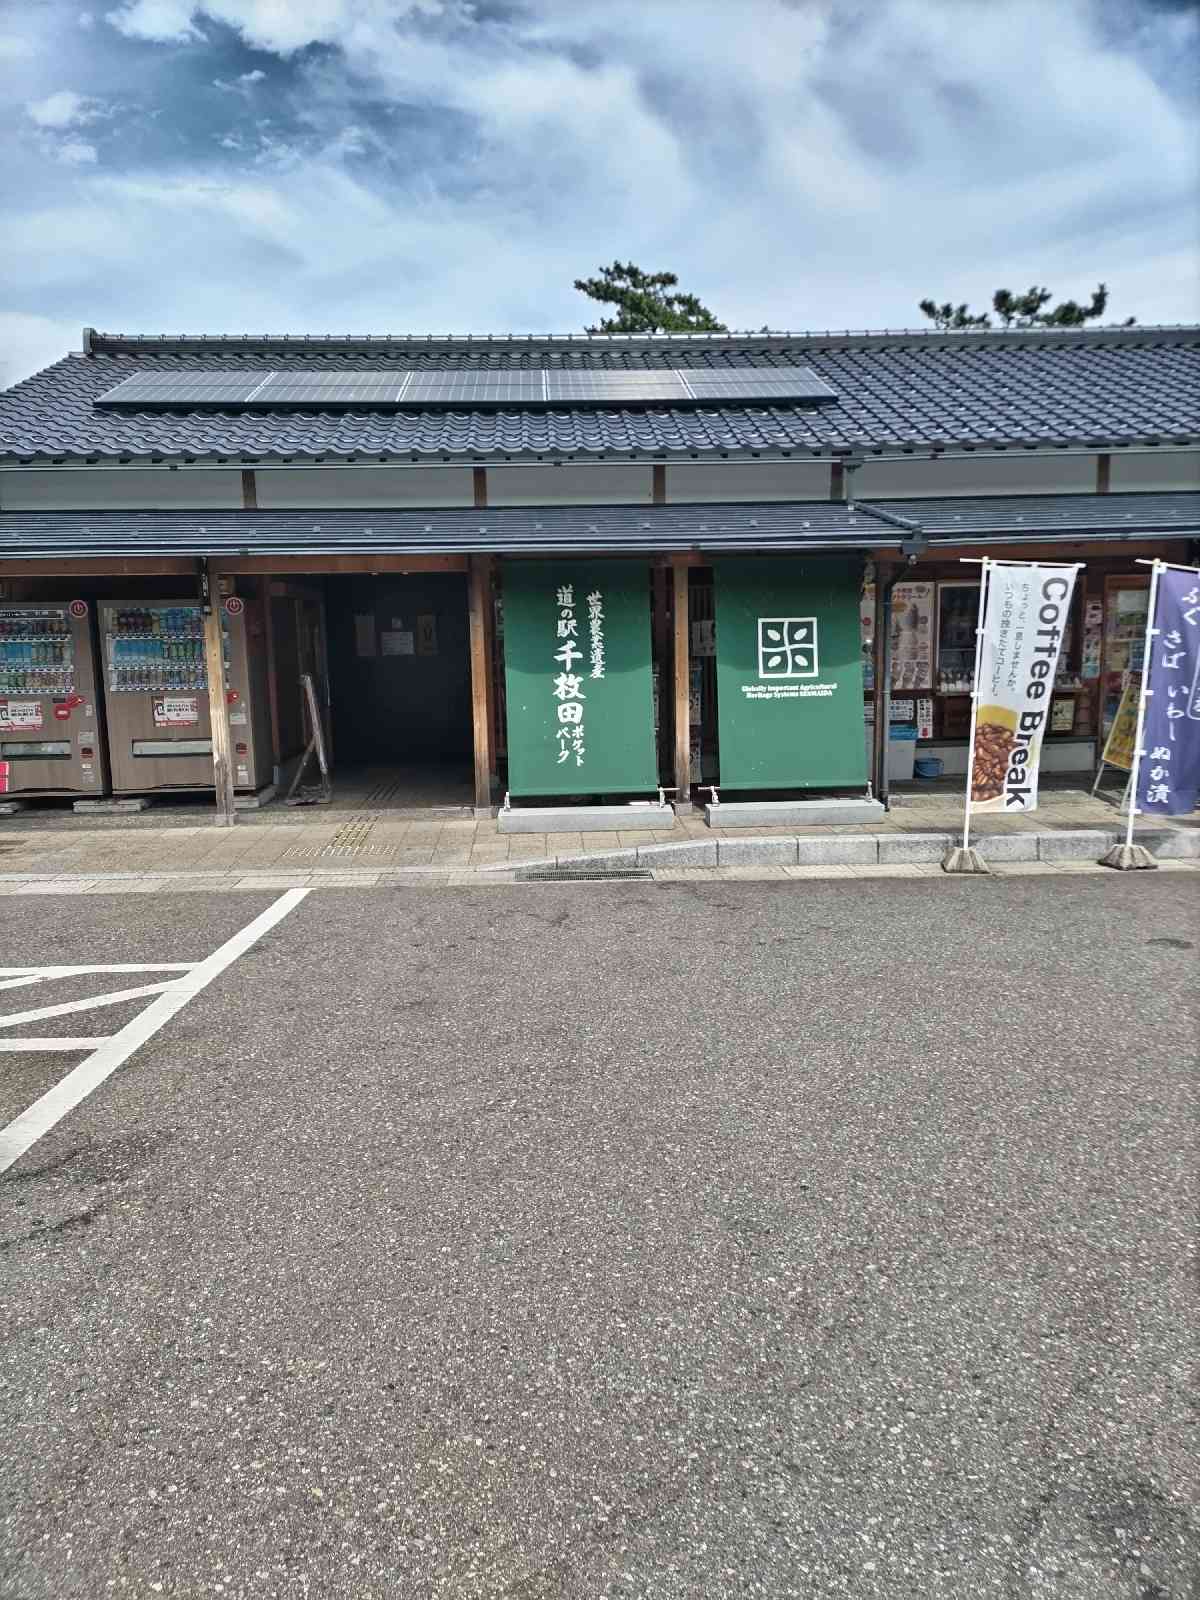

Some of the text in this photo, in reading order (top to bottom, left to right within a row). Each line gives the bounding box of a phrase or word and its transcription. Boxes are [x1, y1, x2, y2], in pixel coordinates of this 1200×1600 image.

[1026, 577, 1069, 700] Coffee
[742, 683, 838, 693] Globally Important Agricultural
[555, 726, 571, 764] パーク
[572, 724, 586, 767] ポケット
[1005, 710, 1045, 807] Break
[1146, 746, 1171, 803] ぬか漬
